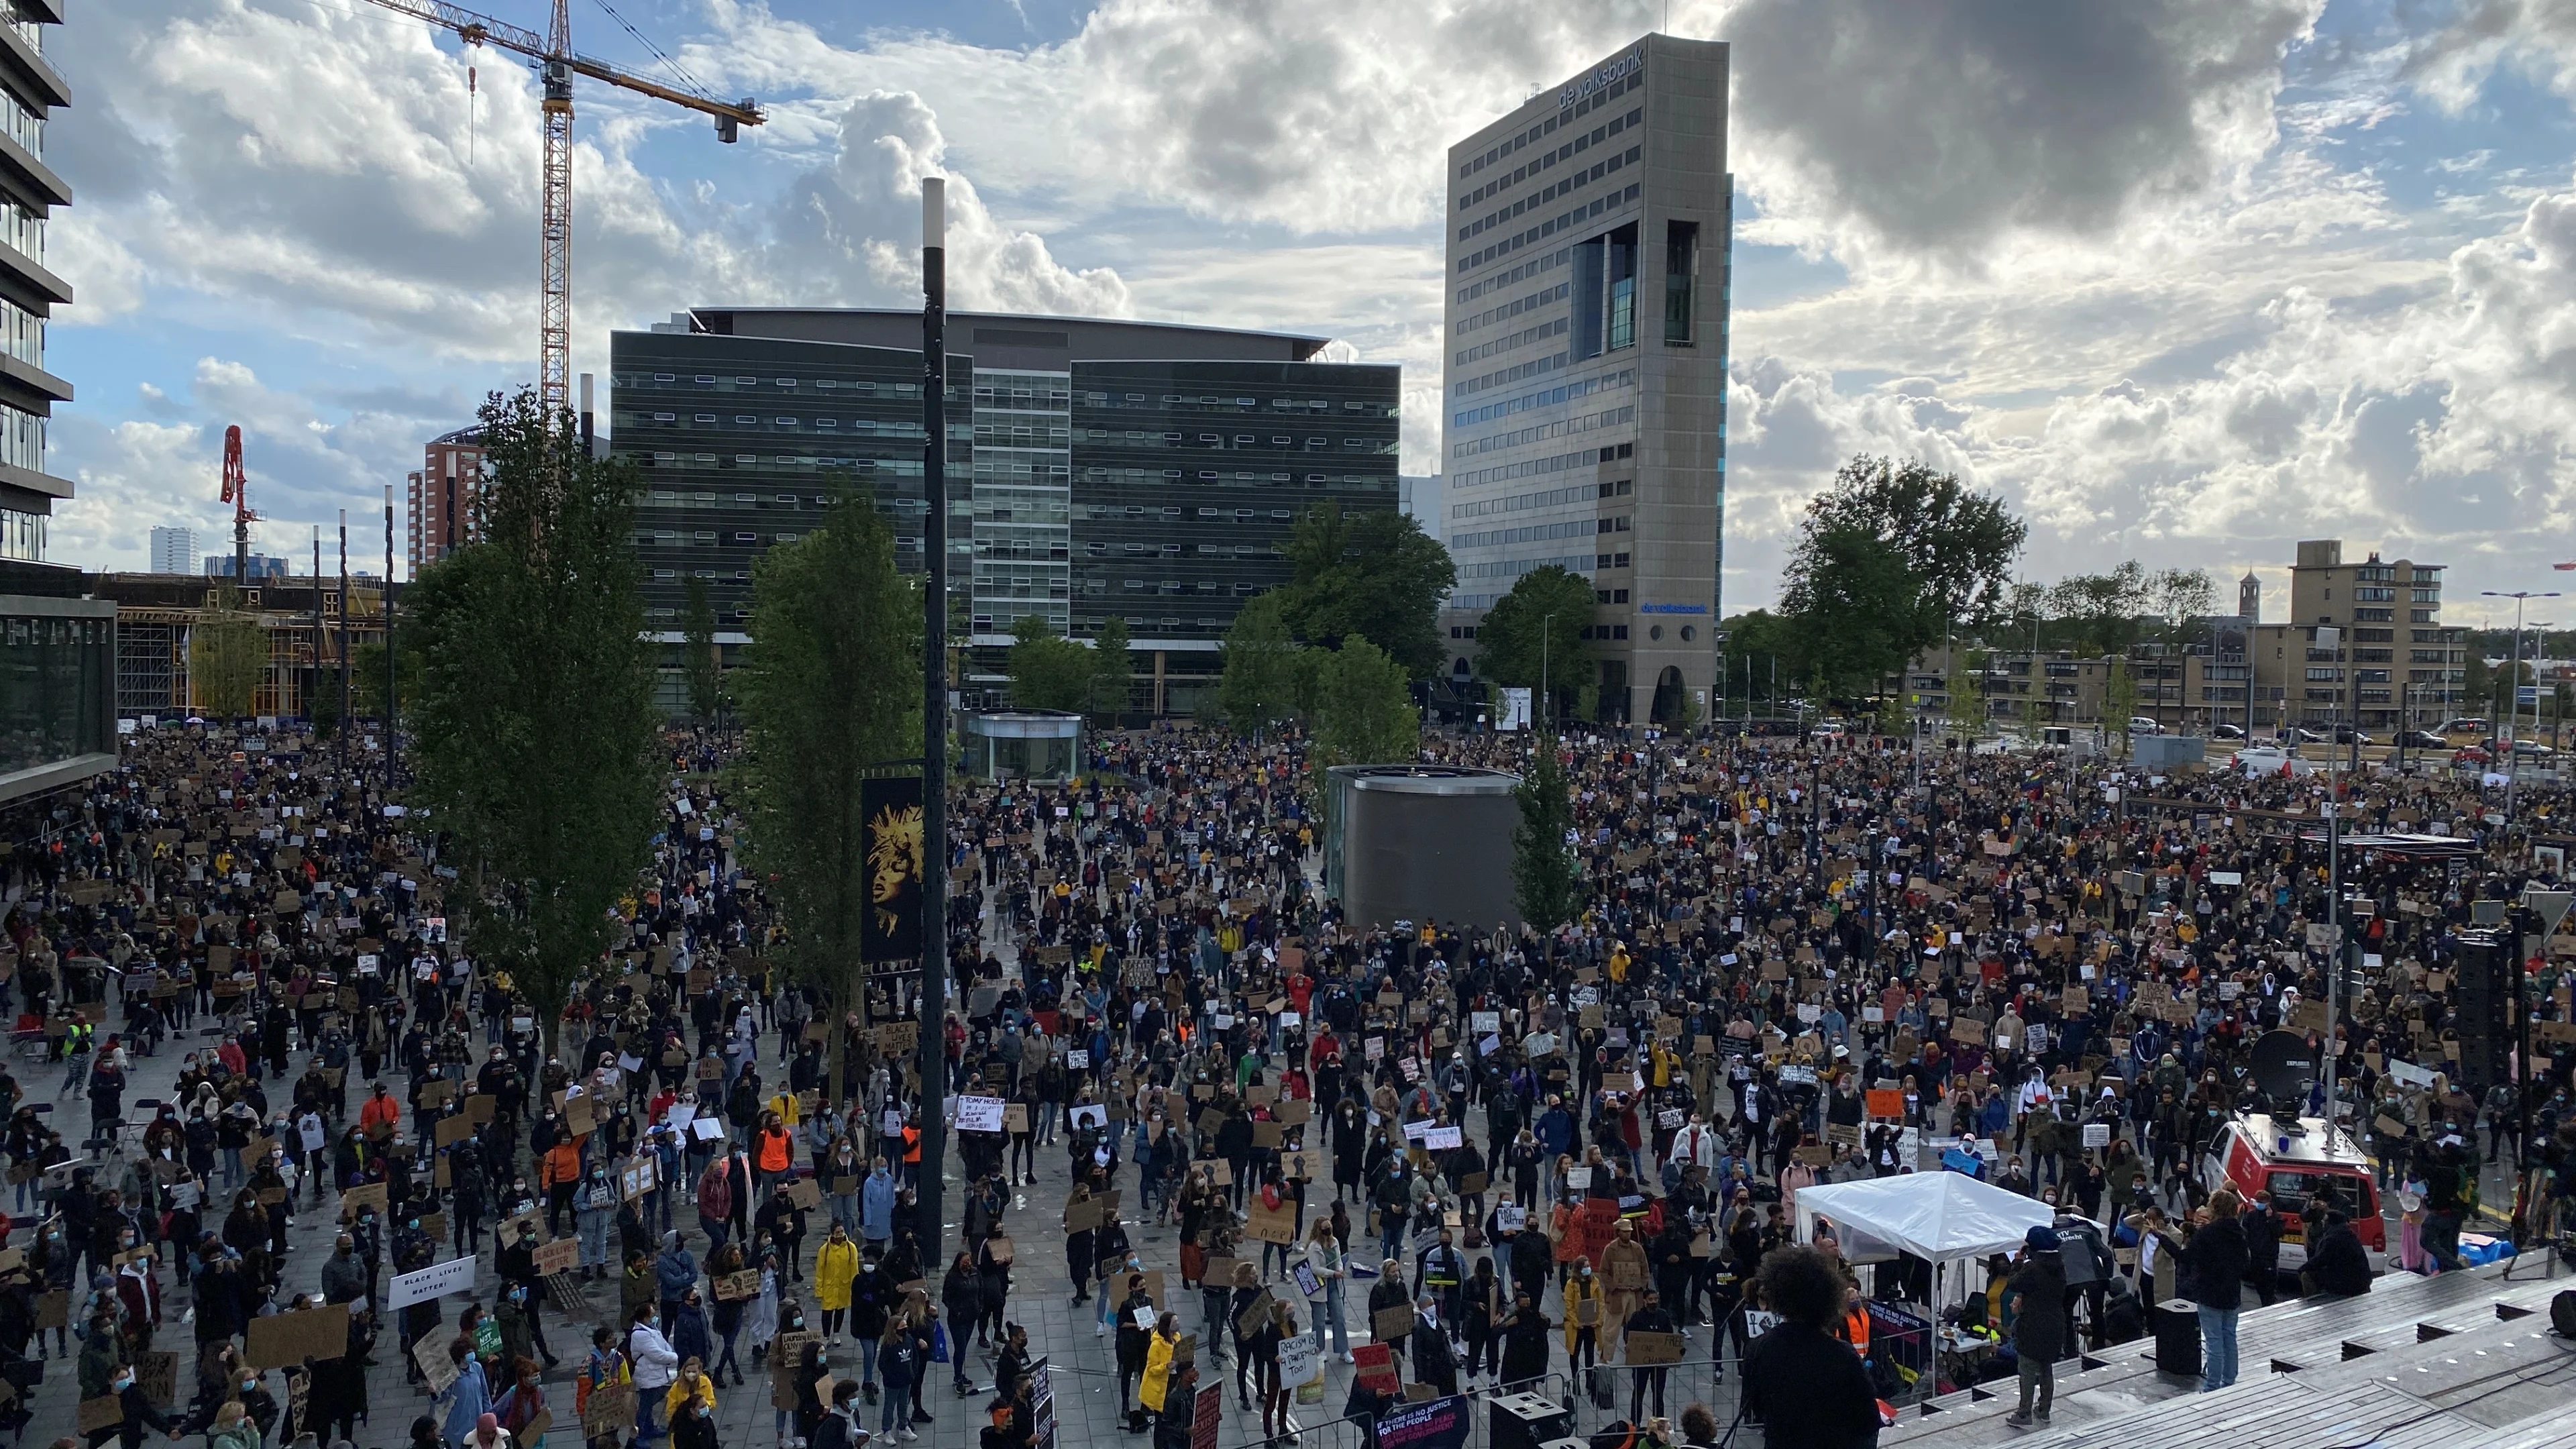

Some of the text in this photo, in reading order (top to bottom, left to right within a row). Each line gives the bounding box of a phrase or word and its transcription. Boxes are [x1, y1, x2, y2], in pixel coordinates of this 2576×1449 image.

[1559, 46, 1643, 109] de volksbank
[1642, 604, 1706, 614] de volksbank
[2142, 988, 2165, 996] LIVES
[885, 1025, 910, 1034] BLACK
[892, 1033, 912, 1041] LIVES
[884, 1042, 912, 1051] MATTER
[1428, 1136, 1461, 1147] OOK HIER
[1835, 1135, 1858, 1143] BETTER
[2276, 1188, 2298, 1196] Utrecht
[2061, 1234, 2083, 1243] trecht
[534, 1244, 577, 1261] BLACK LIVES
[544, 1257, 569, 1270] MATTER
[1104, 1258, 1124, 1268] BLAC
[404, 1266, 463, 1286] BLACK LIVES
[412, 1282, 447, 1295] MATTER!
[1870, 1303, 1886, 1313] THERE
[1892, 1311, 1900, 1319] NO
[1900, 1315, 1920, 1328] JUSTICE
[1875, 1311, 1885, 1320] THE
[1885, 1315, 1904, 1328] PEOPLE
[480, 1332, 492, 1344] NOT
[784, 1334, 806, 1343] Laundry
[1664, 1336, 1684, 1347] FREE
[1280, 1336, 1316, 1353] RACISM IS
[1642, 1344, 1655, 1352] ONE
[1643, 1356, 1676, 1364] CHAINED
[1289, 1361, 1307, 1377] TOO!
[1377, 1399, 1452, 1430] IF THERE IS NO JUSTICE
[1379, 1413, 1432, 1437] FOR THE PEOPLE
[1408, 1422, 1453, 1441] GOVERNMENT
